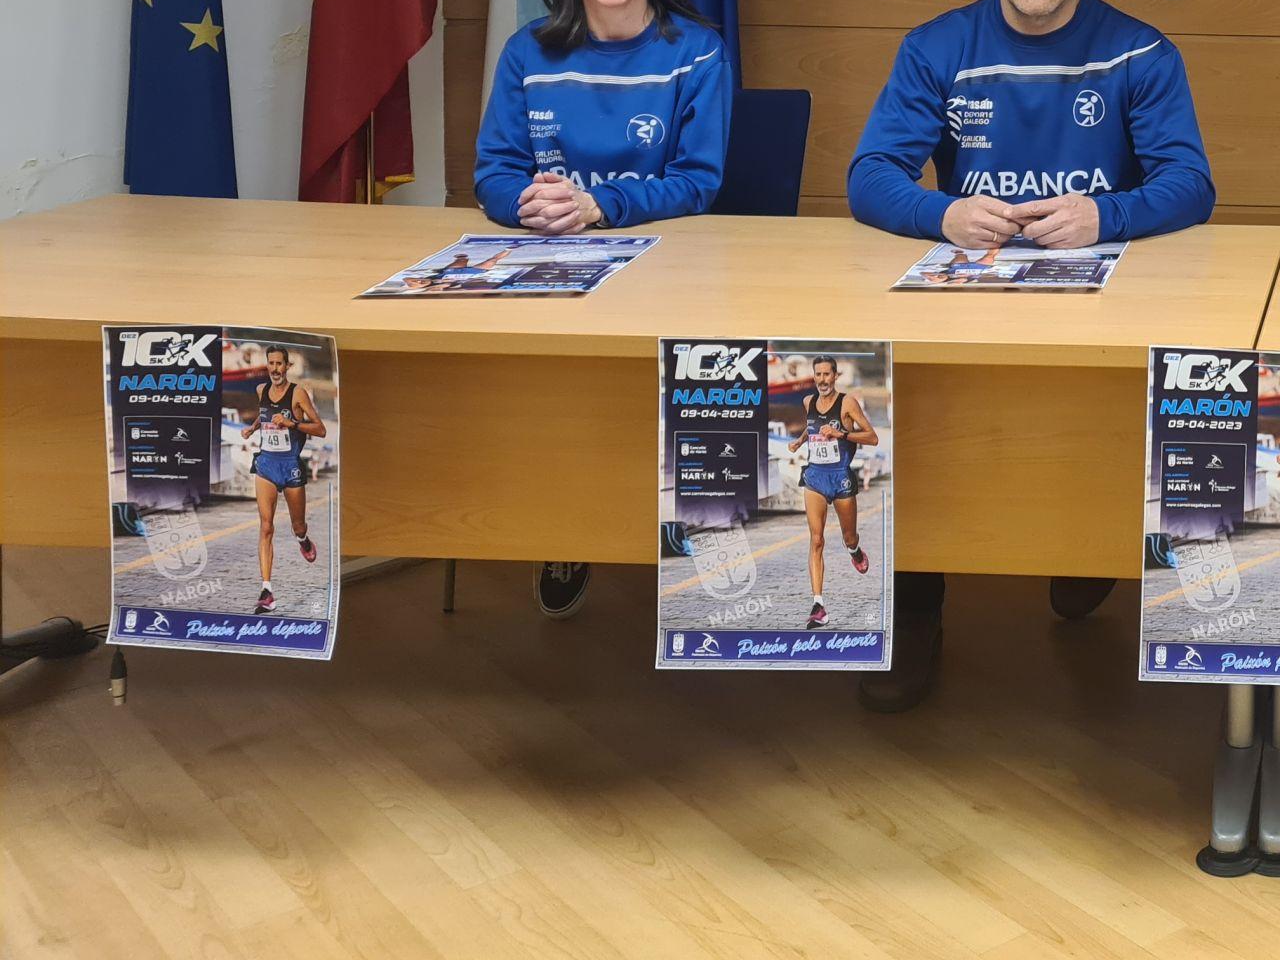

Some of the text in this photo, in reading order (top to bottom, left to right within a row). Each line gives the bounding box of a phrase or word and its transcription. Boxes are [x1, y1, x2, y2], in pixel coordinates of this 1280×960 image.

[118, 368, 216, 391] NARÓN
[129, 395, 207, 404] 09-04-2023
[672, 382, 762, 406] NARÓN
[680, 410, 754, 418] 09-04-2023
[1160, 393, 1252, 416] NARÓN
[1168, 420, 1242, 430] 09-04-2023
[268, 434, 279, 446] 49
[816, 447, 828, 458] 49
[186, 620, 322, 640] Paixón polo deporte
[737, 632, 878, 658] Paixón polo deporte
[1220, 651, 1271, 672] Paixón
